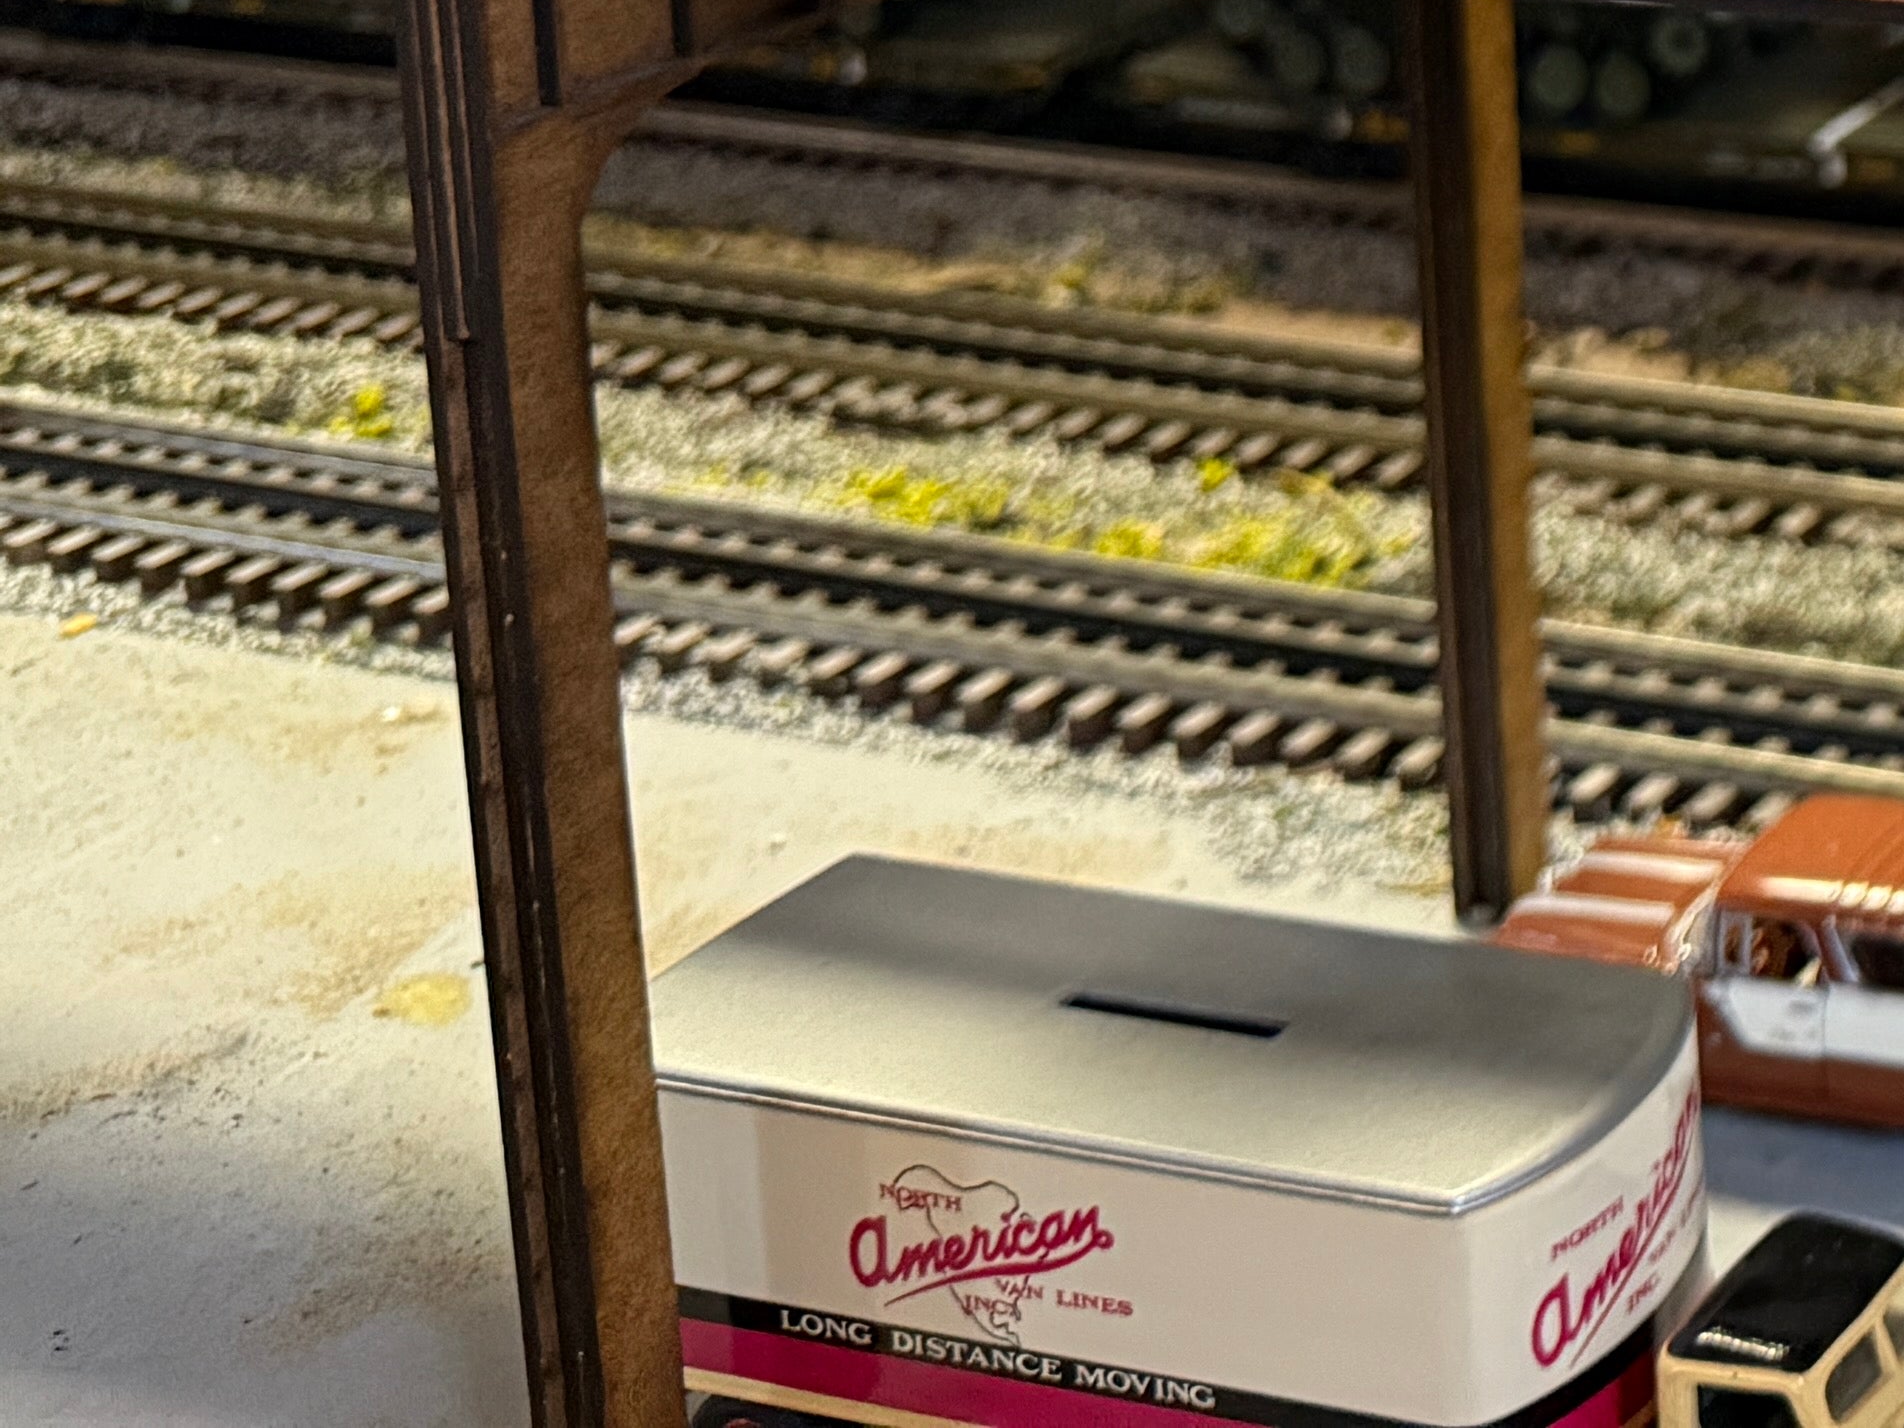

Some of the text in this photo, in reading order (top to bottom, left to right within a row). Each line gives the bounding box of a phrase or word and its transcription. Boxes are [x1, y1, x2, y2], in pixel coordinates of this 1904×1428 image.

[879, 1182, 962, 1212] NORTH
[1551, 1195, 1624, 1260] NORTH
[849, 1204, 1115, 1304] American
[1056, 1289, 1134, 1316] LINES
[780, 1309, 1217, 1410] LONG DISTANCE MOVING
